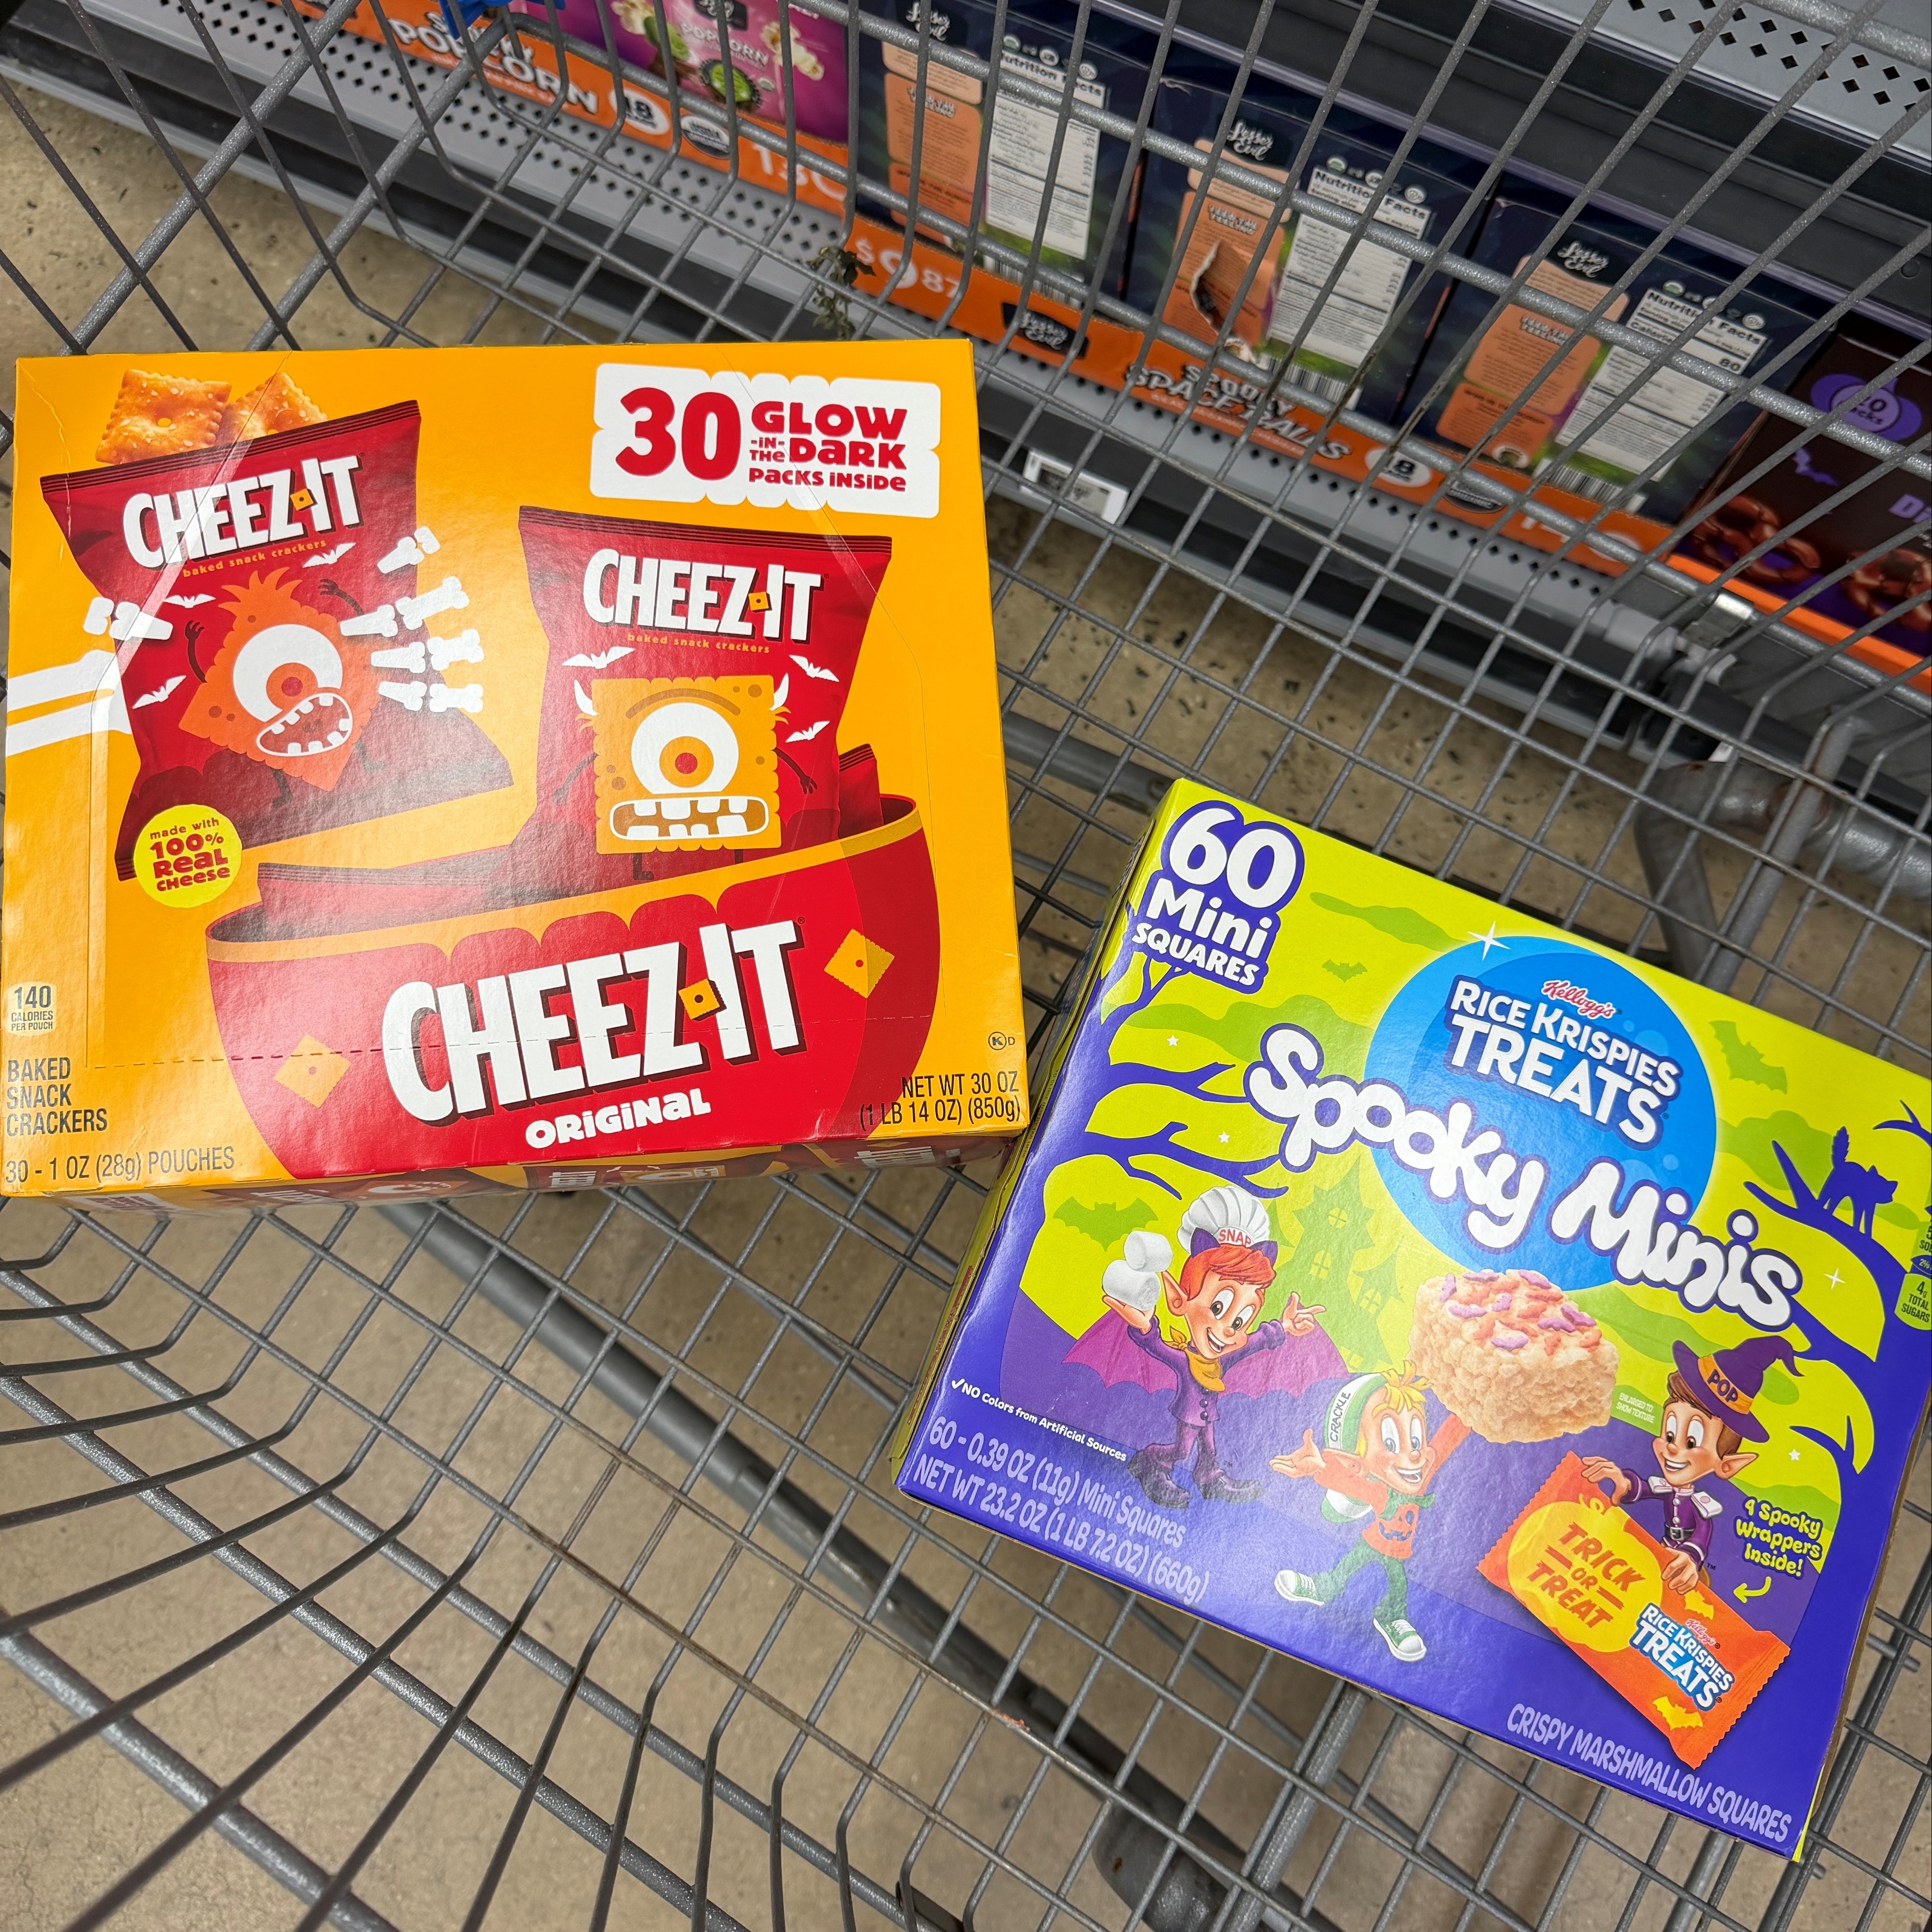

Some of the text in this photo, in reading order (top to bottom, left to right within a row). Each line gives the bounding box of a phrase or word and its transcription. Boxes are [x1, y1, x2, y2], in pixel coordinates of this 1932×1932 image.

[680, 23, 768, 64] POPORN
[1004, 55, 1056, 80] utrition
[1316, 171, 1372, 198] Nutritio
[1647, 292, 1760, 345] Nutritin Facts
[615, 387, 742, 481] 30
[751, 401, 907, 440] GLOW
[182, 540, 326, 578] baked snack crackers
[627, 632, 770, 654] baked snack crackers
[150, 817, 220, 839] made with
[150, 832, 224, 860] 100%
[1169, 808, 1296, 908] 60
[1146, 878, 1272, 959] Mini
[1132, 922, 1260, 986] SQUARES
[11, 1011, 54, 1022] CALORIES
[14, 985, 52, 1010] 140
[1542, 980, 1615, 1018] Kellogg's
[11, 1021, 53, 1031] PER POUCH
[1450, 980, 1679, 1097] RICE KRISPIES
[8, 1057, 71, 1082] BAKED
[902, 1071, 1019, 1099] NET WT 30 OZ
[1450, 1013, 1662, 1144] TREATS
[6, 1083, 72, 1109] SNACK
[859, 1095, 1021, 1131] (1 LB 14 OZ) (850g)
[6, 1108, 108, 1137] CRACKERS
[6, 1159, 28, 1183] 30
[66, 1155, 90, 1179] OZ
[96, 1151, 142, 1183] (28g)
[148, 1146, 234, 1174] POUCHES
[1248, 1029, 1799, 1327] Spooky Minis
[1218, 1229, 1251, 1247] SNAP
[1901, 1303, 1930, 1323] SUGARS
[1909, 1293, 1929, 1311] TOTAL
[1707, 1369, 1739, 1403] POP
[982, 1392, 1014, 1414] Colors
[1015, 1407, 1038, 1424] from
[1038, 1417, 1086, 1444] Artificial
[1086, 1437, 1127, 1462] Sources
[1330, 1392, 1351, 1442] CRACKLE
[1646, 1403, 1653, 1413] TO
[929, 1416, 957, 1450] 60
[967, 1432, 1009, 1472] 0.39
[1007, 1449, 1036, 1483] OZ
[1032, 1457, 1080, 1506] (11g)
[1077, 1478, 1122, 1519] Mini
[1115, 1495, 1186, 1548] Squares
[913, 1454, 955, 1489] NET
[952, 1469, 986, 1506] WT
[980, 1482, 1021, 1522] 23.2
[1019, 1497, 1048, 1533] OZ
[1063, 1516, 1091, 1551] LB
[1089, 1527, 1116, 1562] 7.2
[1114, 1538, 1150, 1578] OZ)
[1147, 1551, 1211, 1606] (660g)
[1736, 1519, 1822, 1560] Wrappers
[1758, 1503, 1822, 1542] Spooky
[1558, 1521, 1646, 1593] TRICK
[1744, 1543, 1804, 1577] Inside!
[1526, 1561, 1617, 1629] TREAT
[1571, 1567, 1598, 1590] OR
[1641, 1605, 1733, 1690] RICE KRISPIES
[1685, 1619, 1716, 1645] Kellogg's
[1632, 1620, 1719, 1708] TREATS
[1507, 1703, 1792, 1843] CRISPY MARSHMALLOW SQUARES
